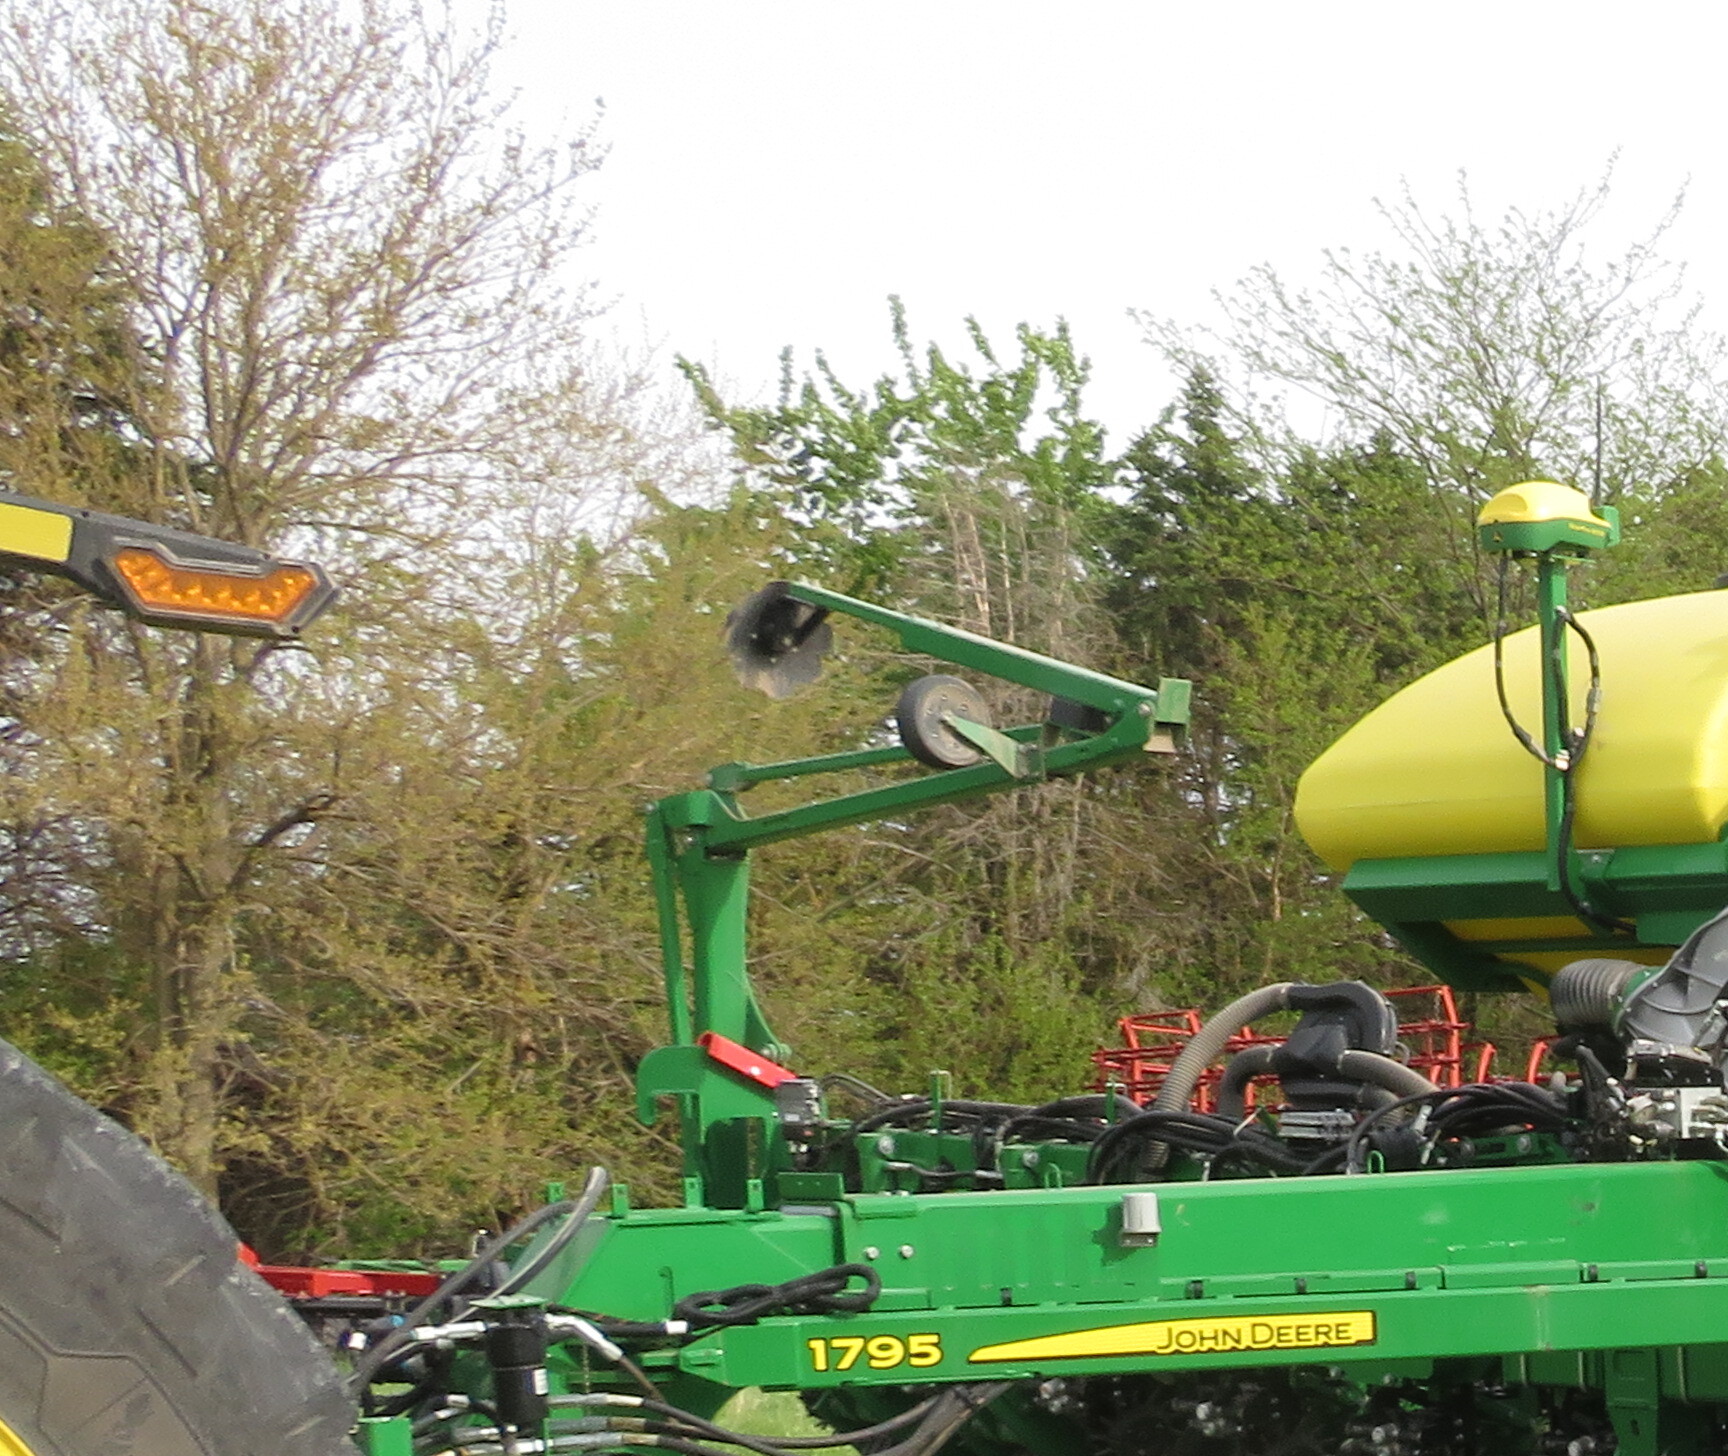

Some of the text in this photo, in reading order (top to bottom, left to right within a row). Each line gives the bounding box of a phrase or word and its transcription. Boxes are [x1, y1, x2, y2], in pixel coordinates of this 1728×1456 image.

[807, 1333, 944, 1372] 1795
[1157, 1322, 1352, 1350] JOHN DEERE
